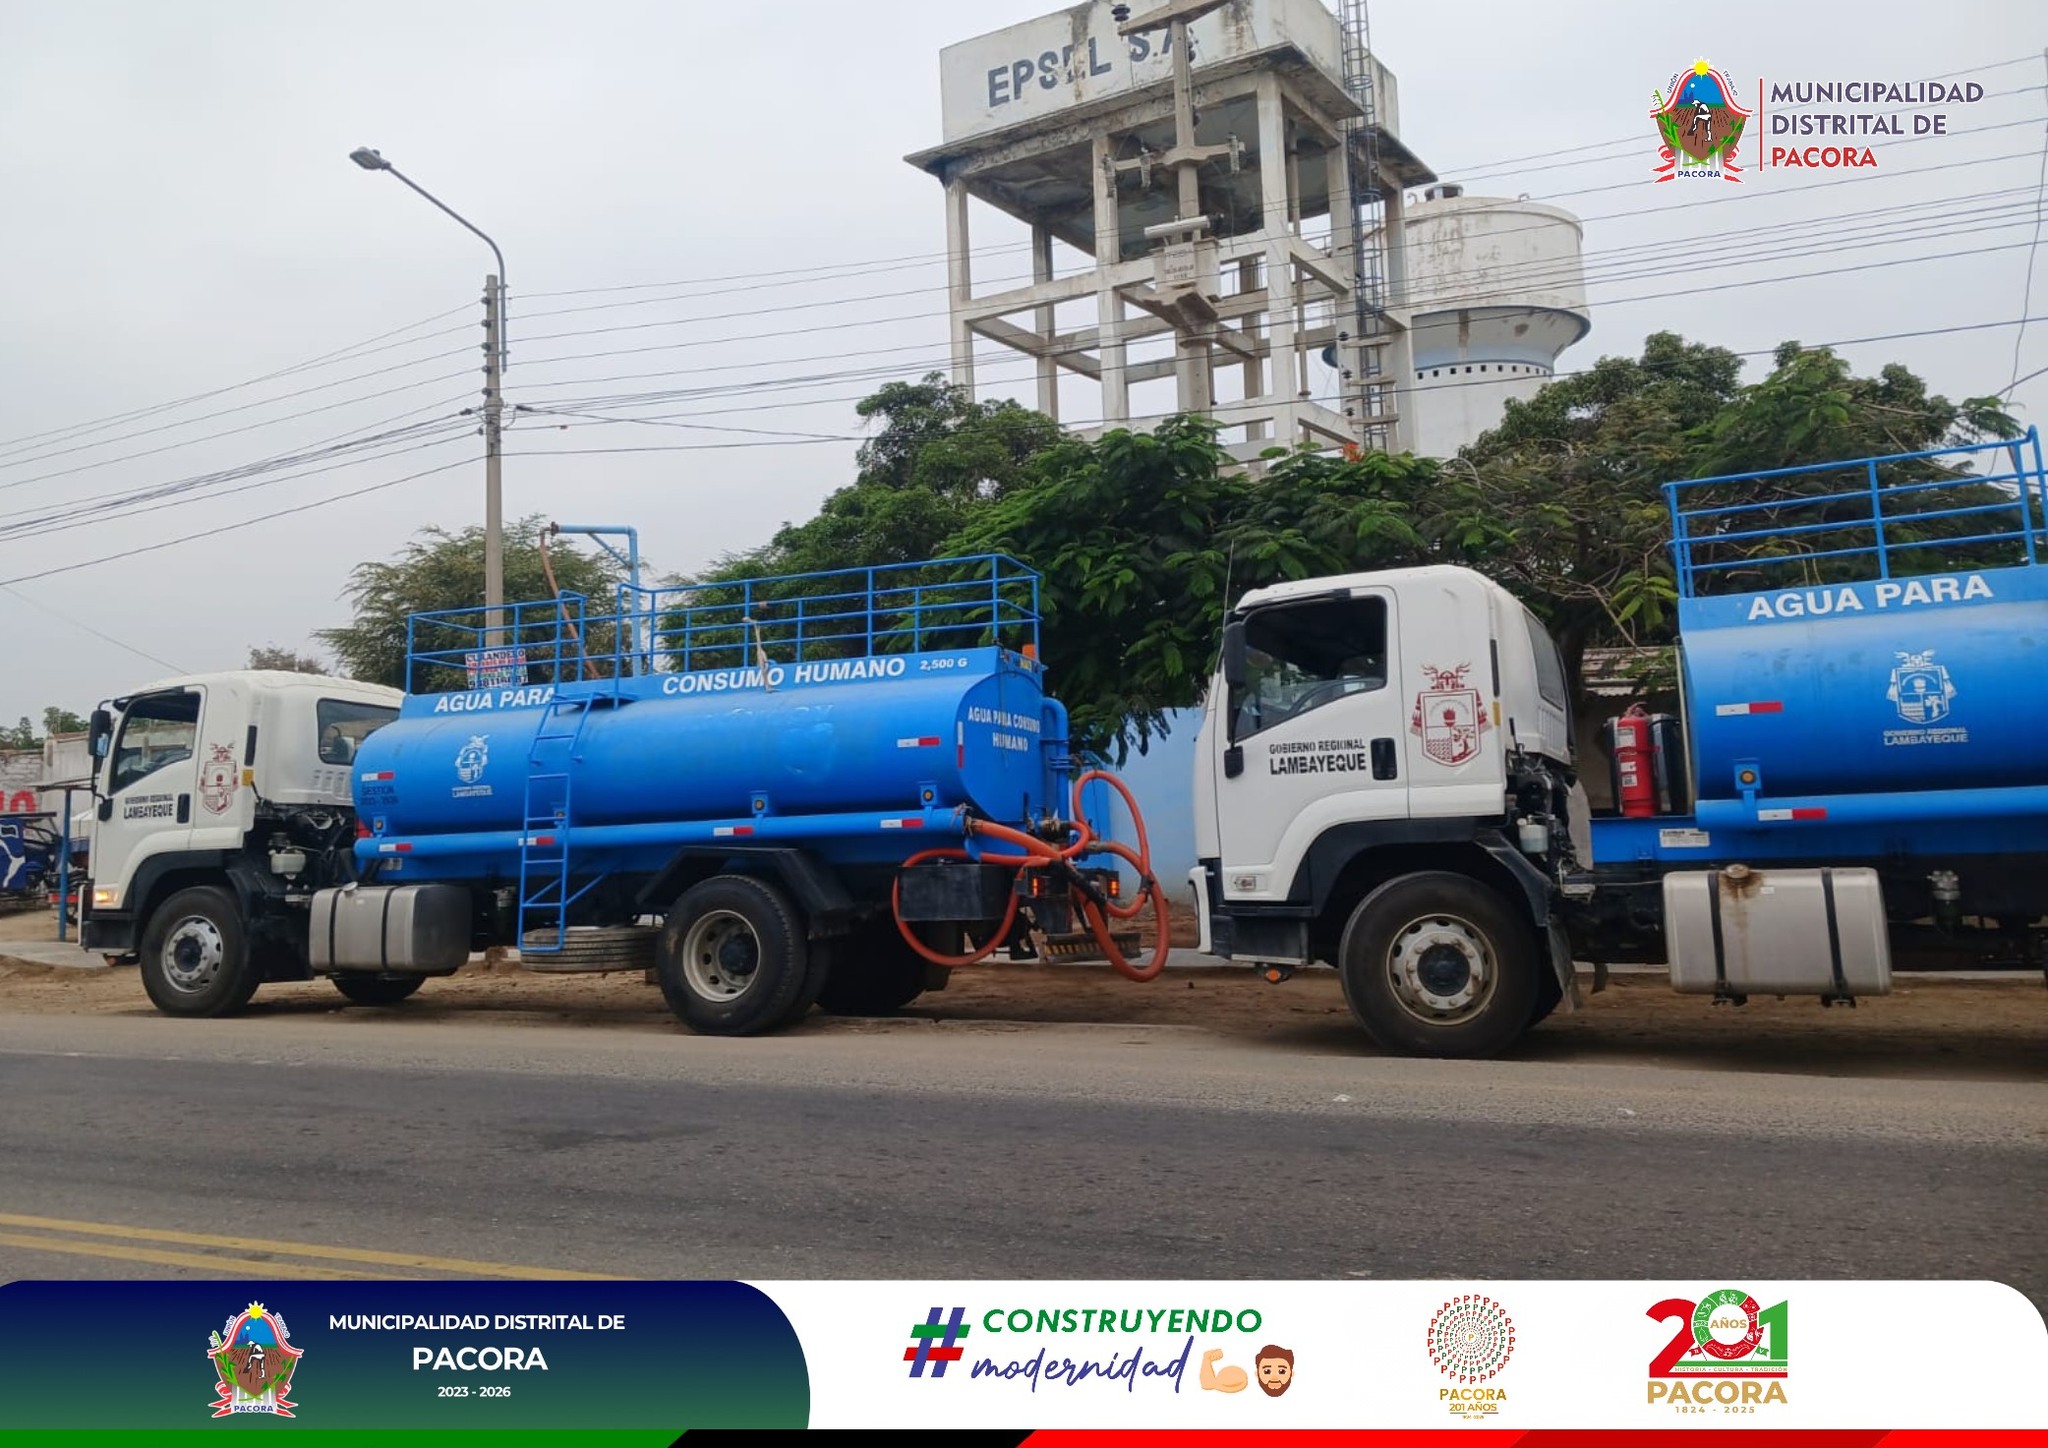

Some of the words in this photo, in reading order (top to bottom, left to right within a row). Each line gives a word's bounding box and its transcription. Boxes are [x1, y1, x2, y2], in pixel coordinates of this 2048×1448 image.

[1748, 588, 1864, 620] AGUA
[1875, 574, 1994, 609] PARA
[434, 692, 493, 713] AGUA
[499, 687, 555, 708] PARA
[663, 667, 785, 695] CONSUMO
[794, 657, 905, 683] HUMANO
[919, 658, 955, 671] 2,500
[957, 658, 968, 668] G
[968, 705, 992, 724] AGUA
[992, 709, 1013, 727] PARA
[992, 731, 1029, 751] HUMANO
[1269, 742, 1316, 754] GOBIERNO
[1318, 738, 1366, 751] REGIONAL
[1884, 733, 1969, 745] LAMBAYEQUE
[1270, 753, 1367, 775] LAMBAYEQUE
[124, 804, 173, 820] LAMBAYEQUE
